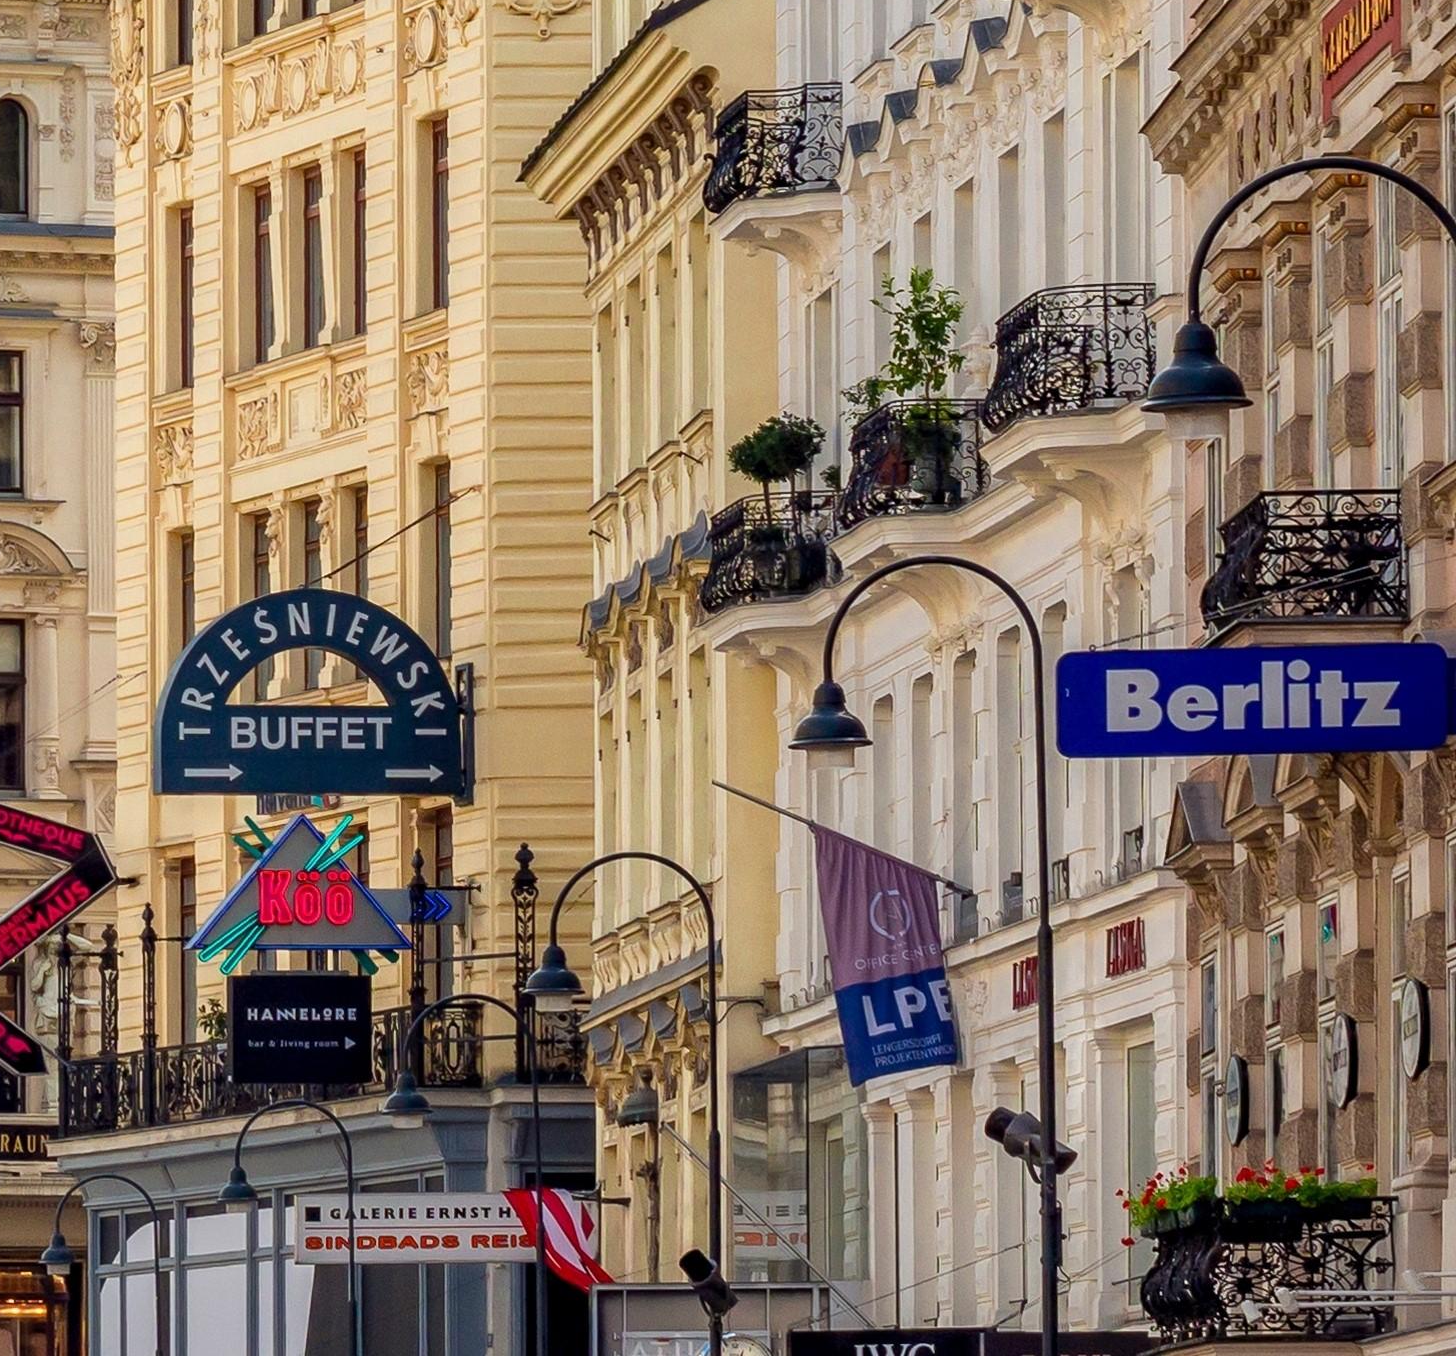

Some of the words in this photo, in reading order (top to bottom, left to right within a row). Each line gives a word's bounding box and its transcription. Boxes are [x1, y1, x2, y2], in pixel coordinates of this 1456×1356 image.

[1106, 659, 1401, 732] Berlitz
[231, 716, 392, 750] BUFFET
[247, 1008, 357, 1021] HANNELORE
[248, 1039, 264, 1048] bar
[330, 1207, 417, 1220] GALERIE
[426, 1207, 491, 1219] ERNST
[304, 1235, 460, 1250] SINDBADS
